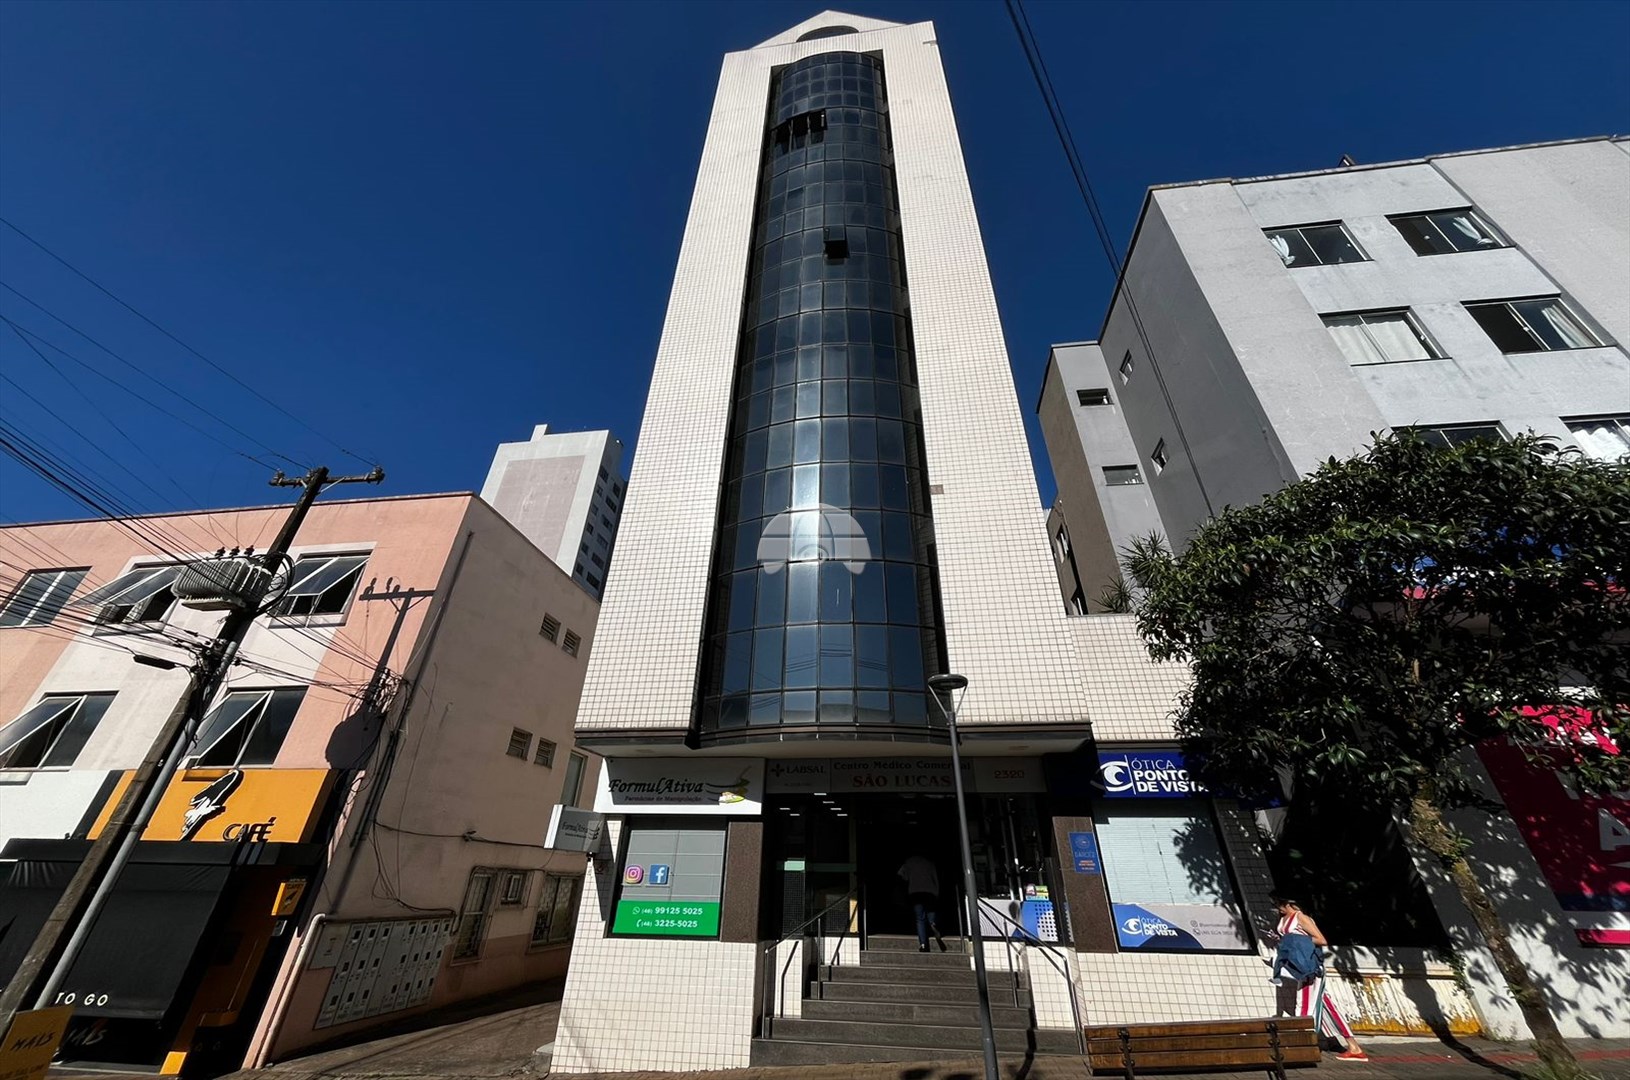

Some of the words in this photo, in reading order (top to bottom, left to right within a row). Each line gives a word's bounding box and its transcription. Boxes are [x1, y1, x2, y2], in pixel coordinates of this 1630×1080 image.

[833, 761, 869, 770] Centro
[916, 760, 970, 770] Comeral
[1131, 757, 1176, 770] ÓTICA
[994, 770, 1025, 779] 2320
[608, 777, 704, 794] FormulAtiva
[852, 773, 887, 788] SÃO
[895, 775, 952, 788] LUCAS
[1137, 781, 1159, 793] DE
[222, 816, 276, 843] CAFÉ
[655, 906, 680, 915] 99125
[682, 907, 703, 915] 5025
[654, 919, 698, 928] 3225-5025
[1143, 923, 1169, 931] PONTO
[1155, 929, 1179, 937] VISTA
[54, 991, 76, 1005] TO
[83, 993, 109, 1007] GO
